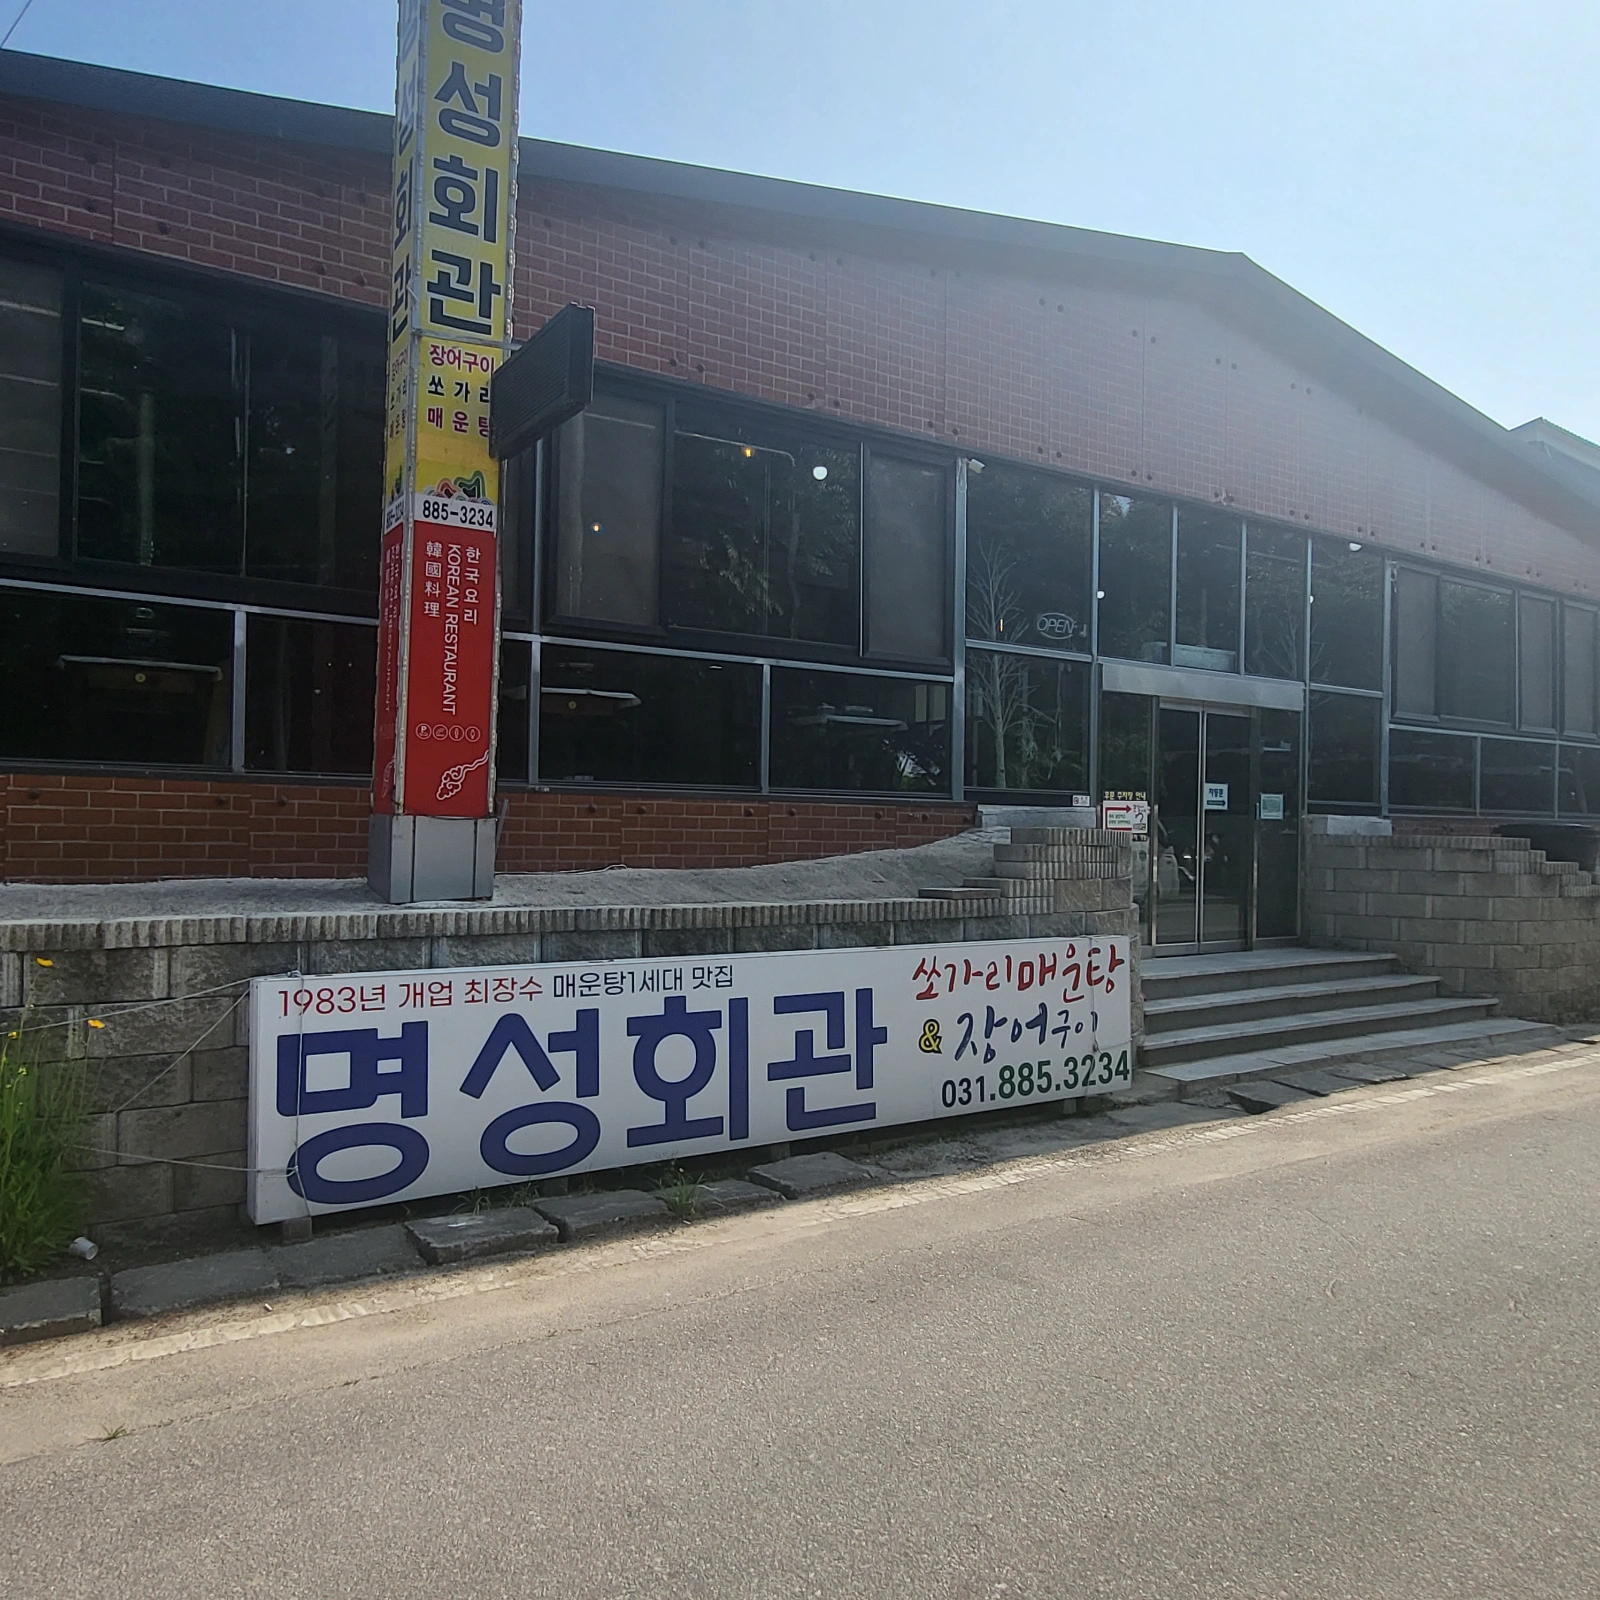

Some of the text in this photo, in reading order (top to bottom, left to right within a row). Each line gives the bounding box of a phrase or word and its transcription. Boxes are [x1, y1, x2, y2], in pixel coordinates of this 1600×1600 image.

[429, 344, 494, 373] 장어구이
[422, 500, 494, 528] 885-3234
[423, 541, 443, 618] 韓國料理
[463, 546, 481, 625] 한국요리
[442, 543, 461, 715] KOREAN RESTAURANT
[1037, 617, 1074, 633] OPEN
[278, 985, 386, 1017] 1983년
[398, 980, 453, 1008] 개업
[464, 976, 544, 1005] 최장수
[692, 964, 734, 989] 맛집
[918, 1002, 1098, 1064] & 장어구이
[277, 988, 888, 1204] 명성회관
[941, 1050, 1130, 1108] 031.885.3234
